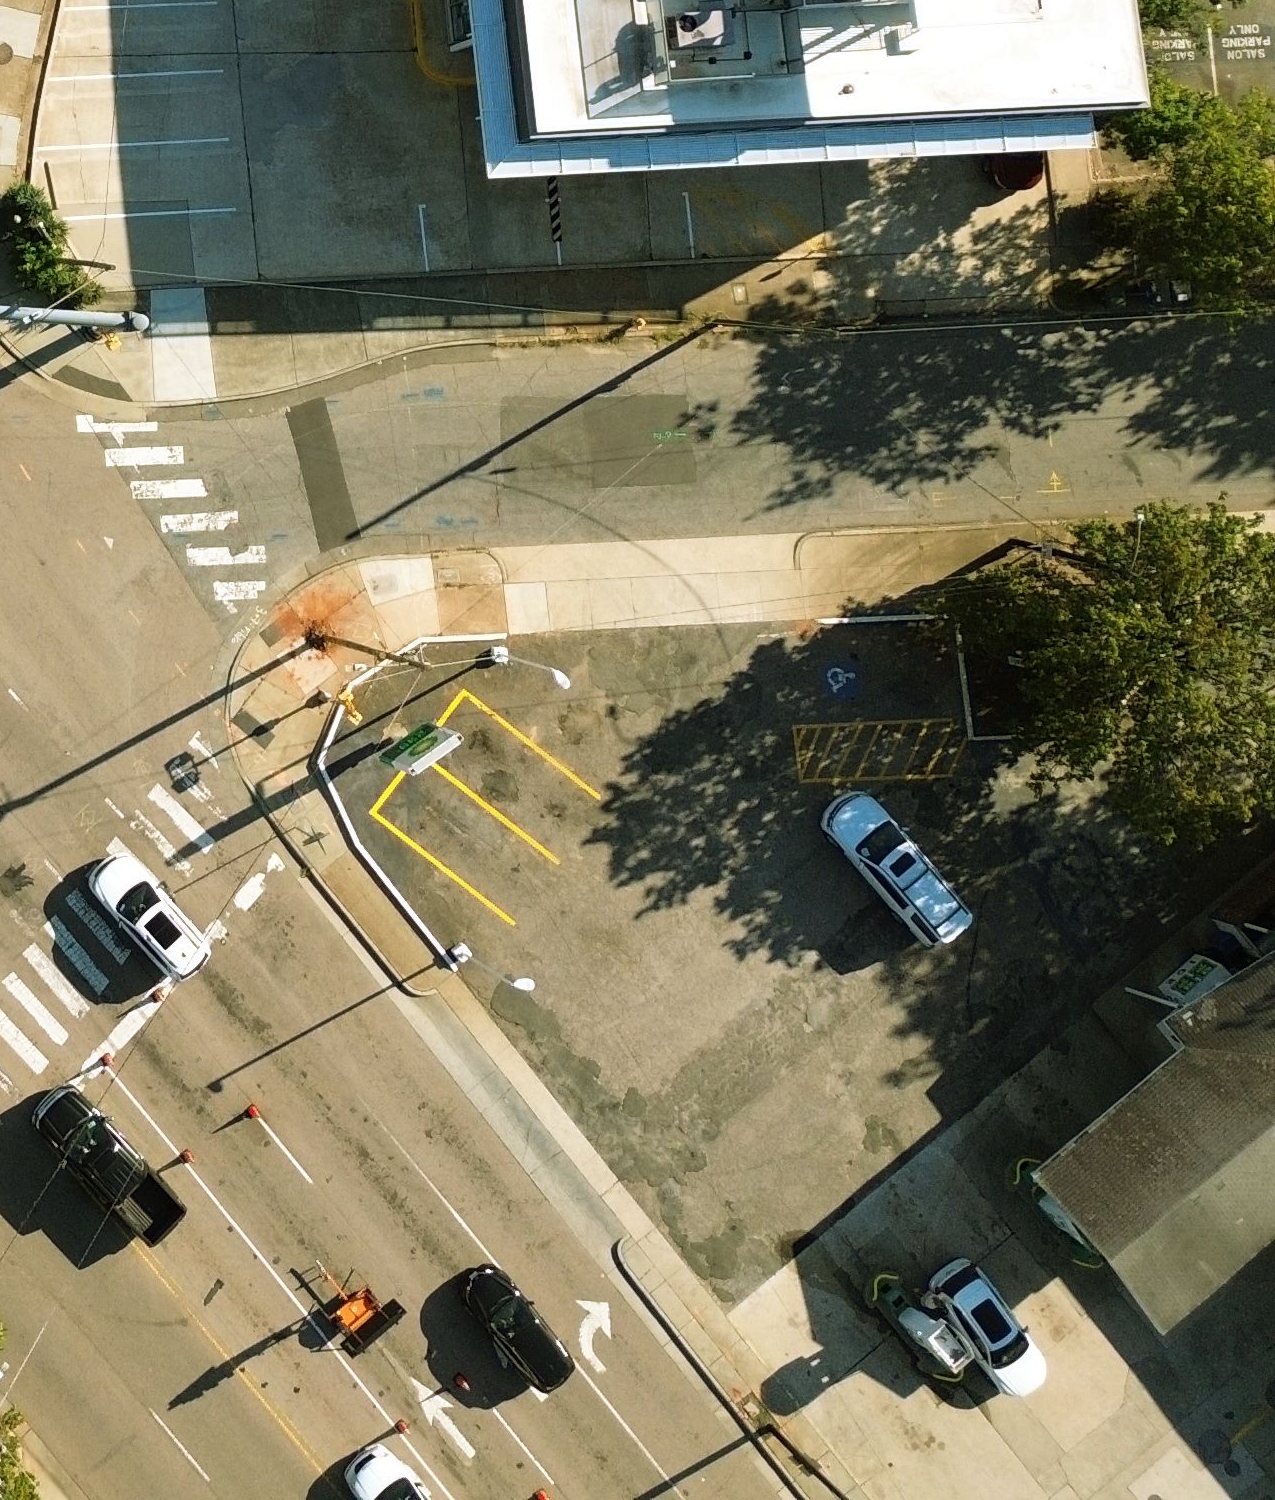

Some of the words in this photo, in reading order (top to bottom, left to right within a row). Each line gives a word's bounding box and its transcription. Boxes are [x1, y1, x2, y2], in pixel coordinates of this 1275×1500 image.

[1229, 24, 1260, 35] ONLY
[1221, 36, 1271, 48] PARKING
[1162, 51, 1195, 62] SALO
[1227, 49, 1266, 60] SALON
